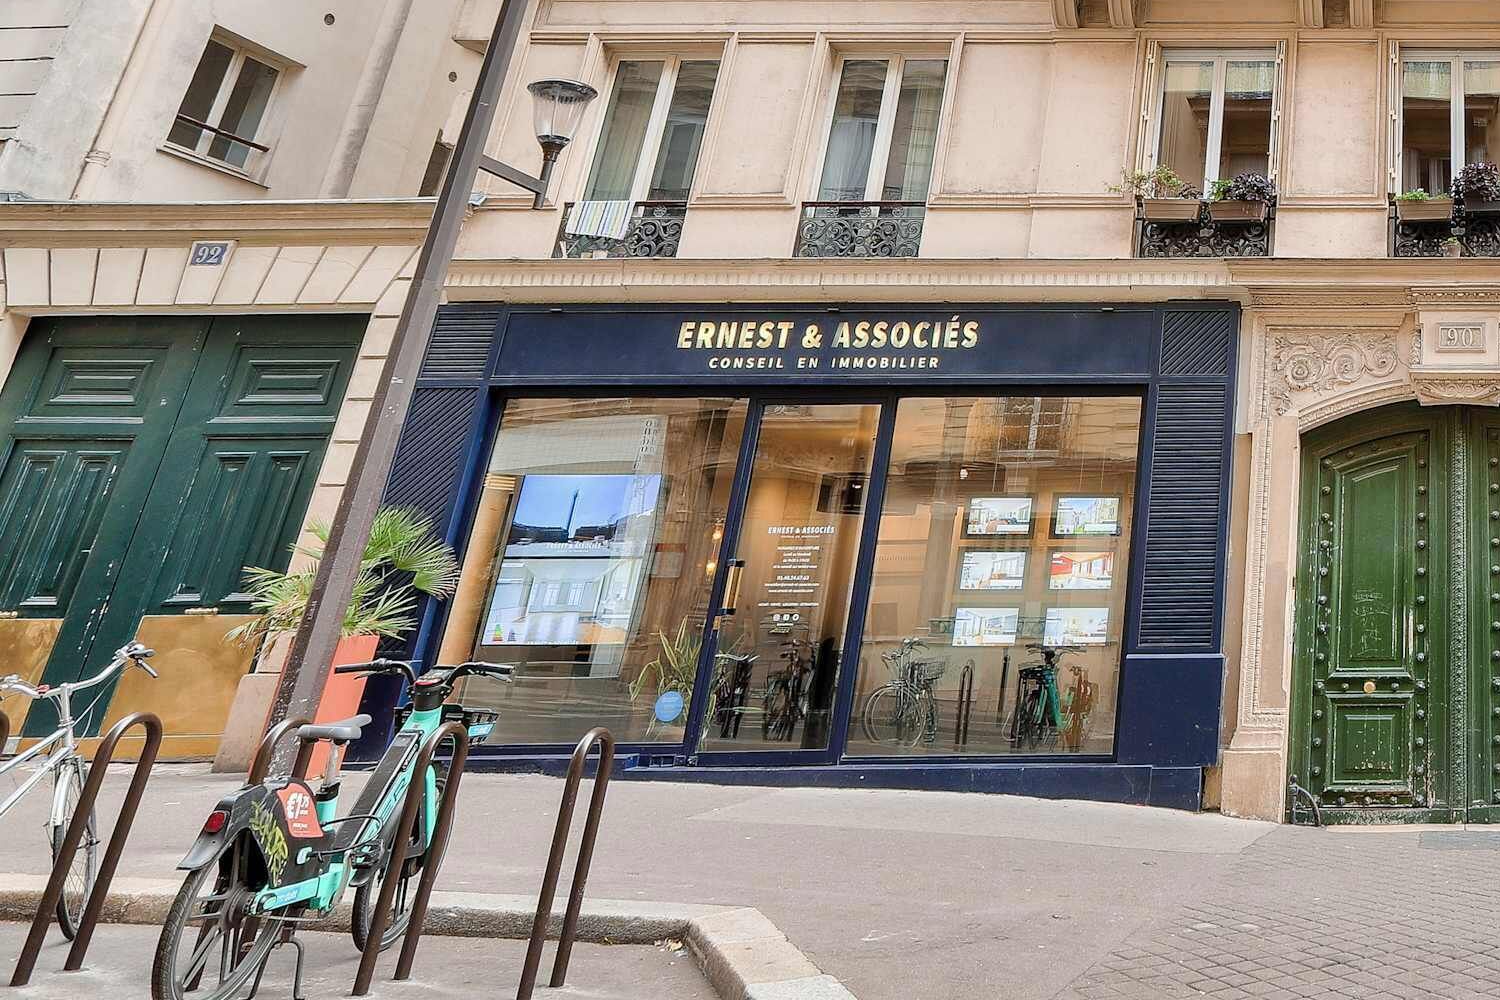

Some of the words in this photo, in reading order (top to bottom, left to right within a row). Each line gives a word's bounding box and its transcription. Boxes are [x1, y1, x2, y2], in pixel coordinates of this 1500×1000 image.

[195, 246, 221, 263] 92
[676, 320, 794, 349] ERNEST
[801, 324, 823, 349] &
[831, 315, 979, 349] ASSOCIÉS
[1446, 328, 1474, 346] 90
[708, 356, 785, 370] CONSEIL
[797, 356, 819, 369] EN
[830, 356, 940, 370] IMMOBILIER
